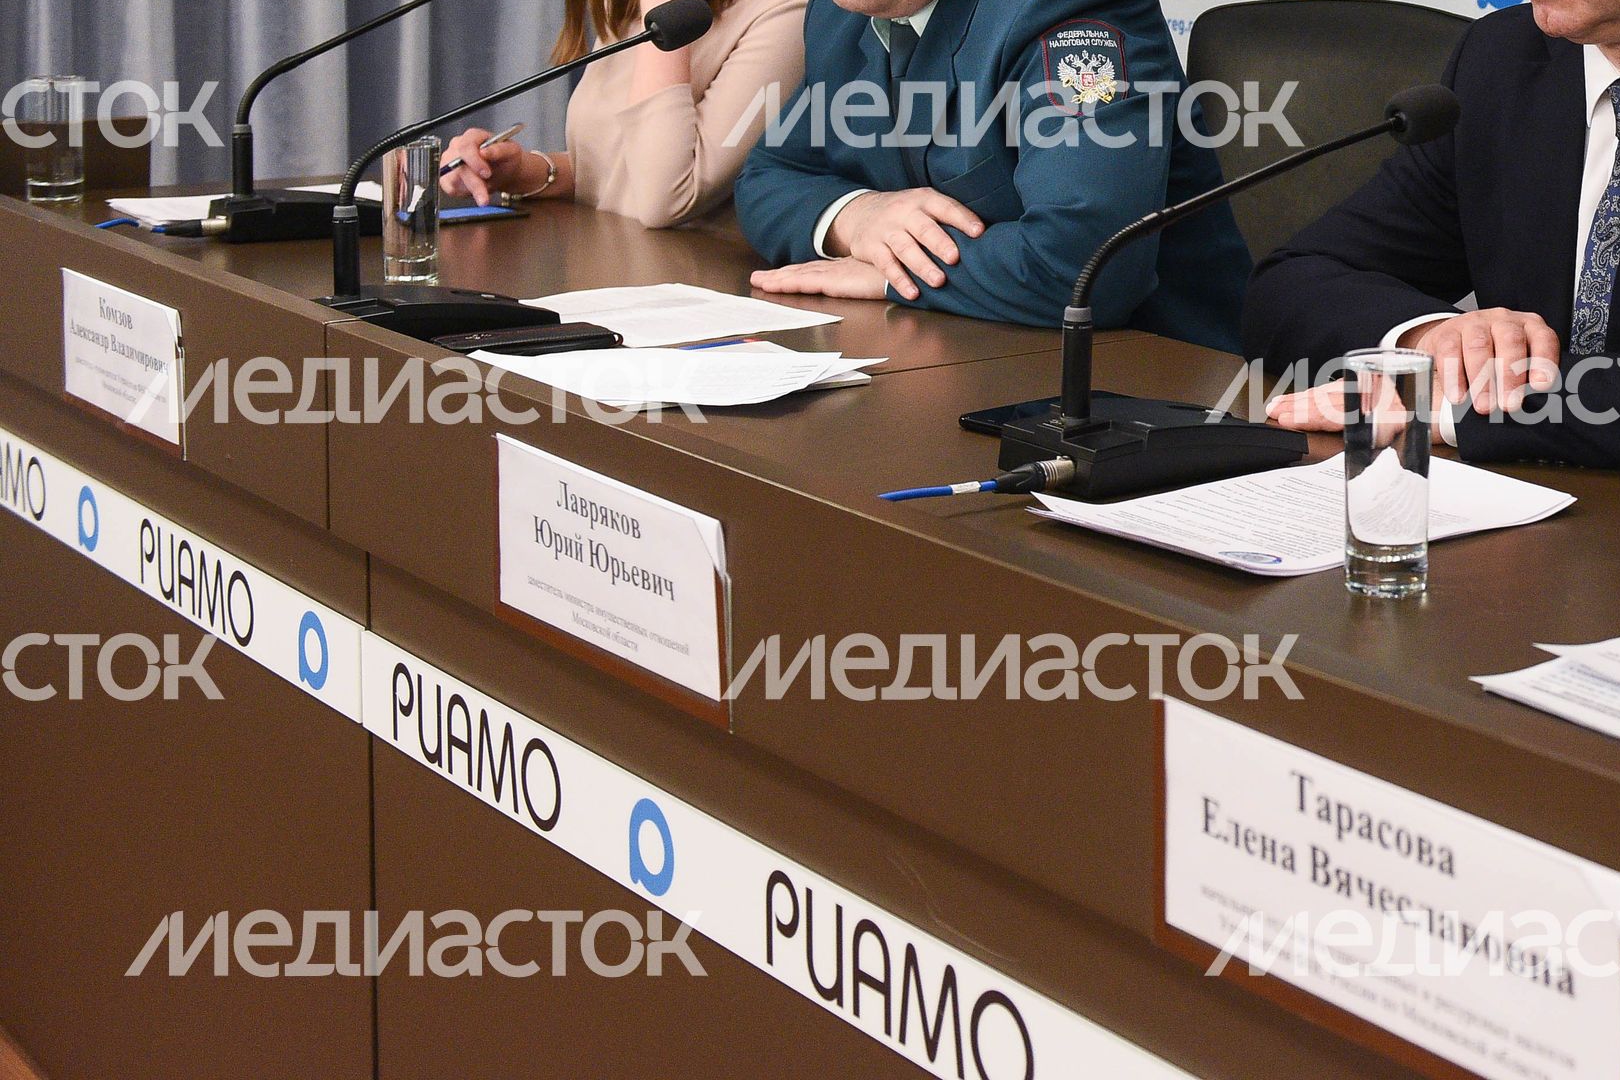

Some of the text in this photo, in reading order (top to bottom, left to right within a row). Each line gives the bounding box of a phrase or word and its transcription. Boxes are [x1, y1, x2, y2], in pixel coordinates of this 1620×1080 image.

[1049, 38, 1118, 48] НАЛОГОВАЯ СЛУЖБА
[1056, 30, 1109, 39] ФЕДЕРАЛЬНАЯ
[70, 320, 110, 353] Александр
[99, 296, 133, 330] Комзов
[556, 479, 641, 539] Лавряков
[139, 518, 255, 648] РИАМО
[533, 514, 675, 601] Юрий Юрьевич
[392, 662, 562, 832] РИАМО
[1289, 769, 1457, 879] Тарасова
[1200, 795, 1297, 875] Елена
[1309, 843, 1576, 999] Вячеславовна
[766, 870, 1034, 1080] РИАМО
